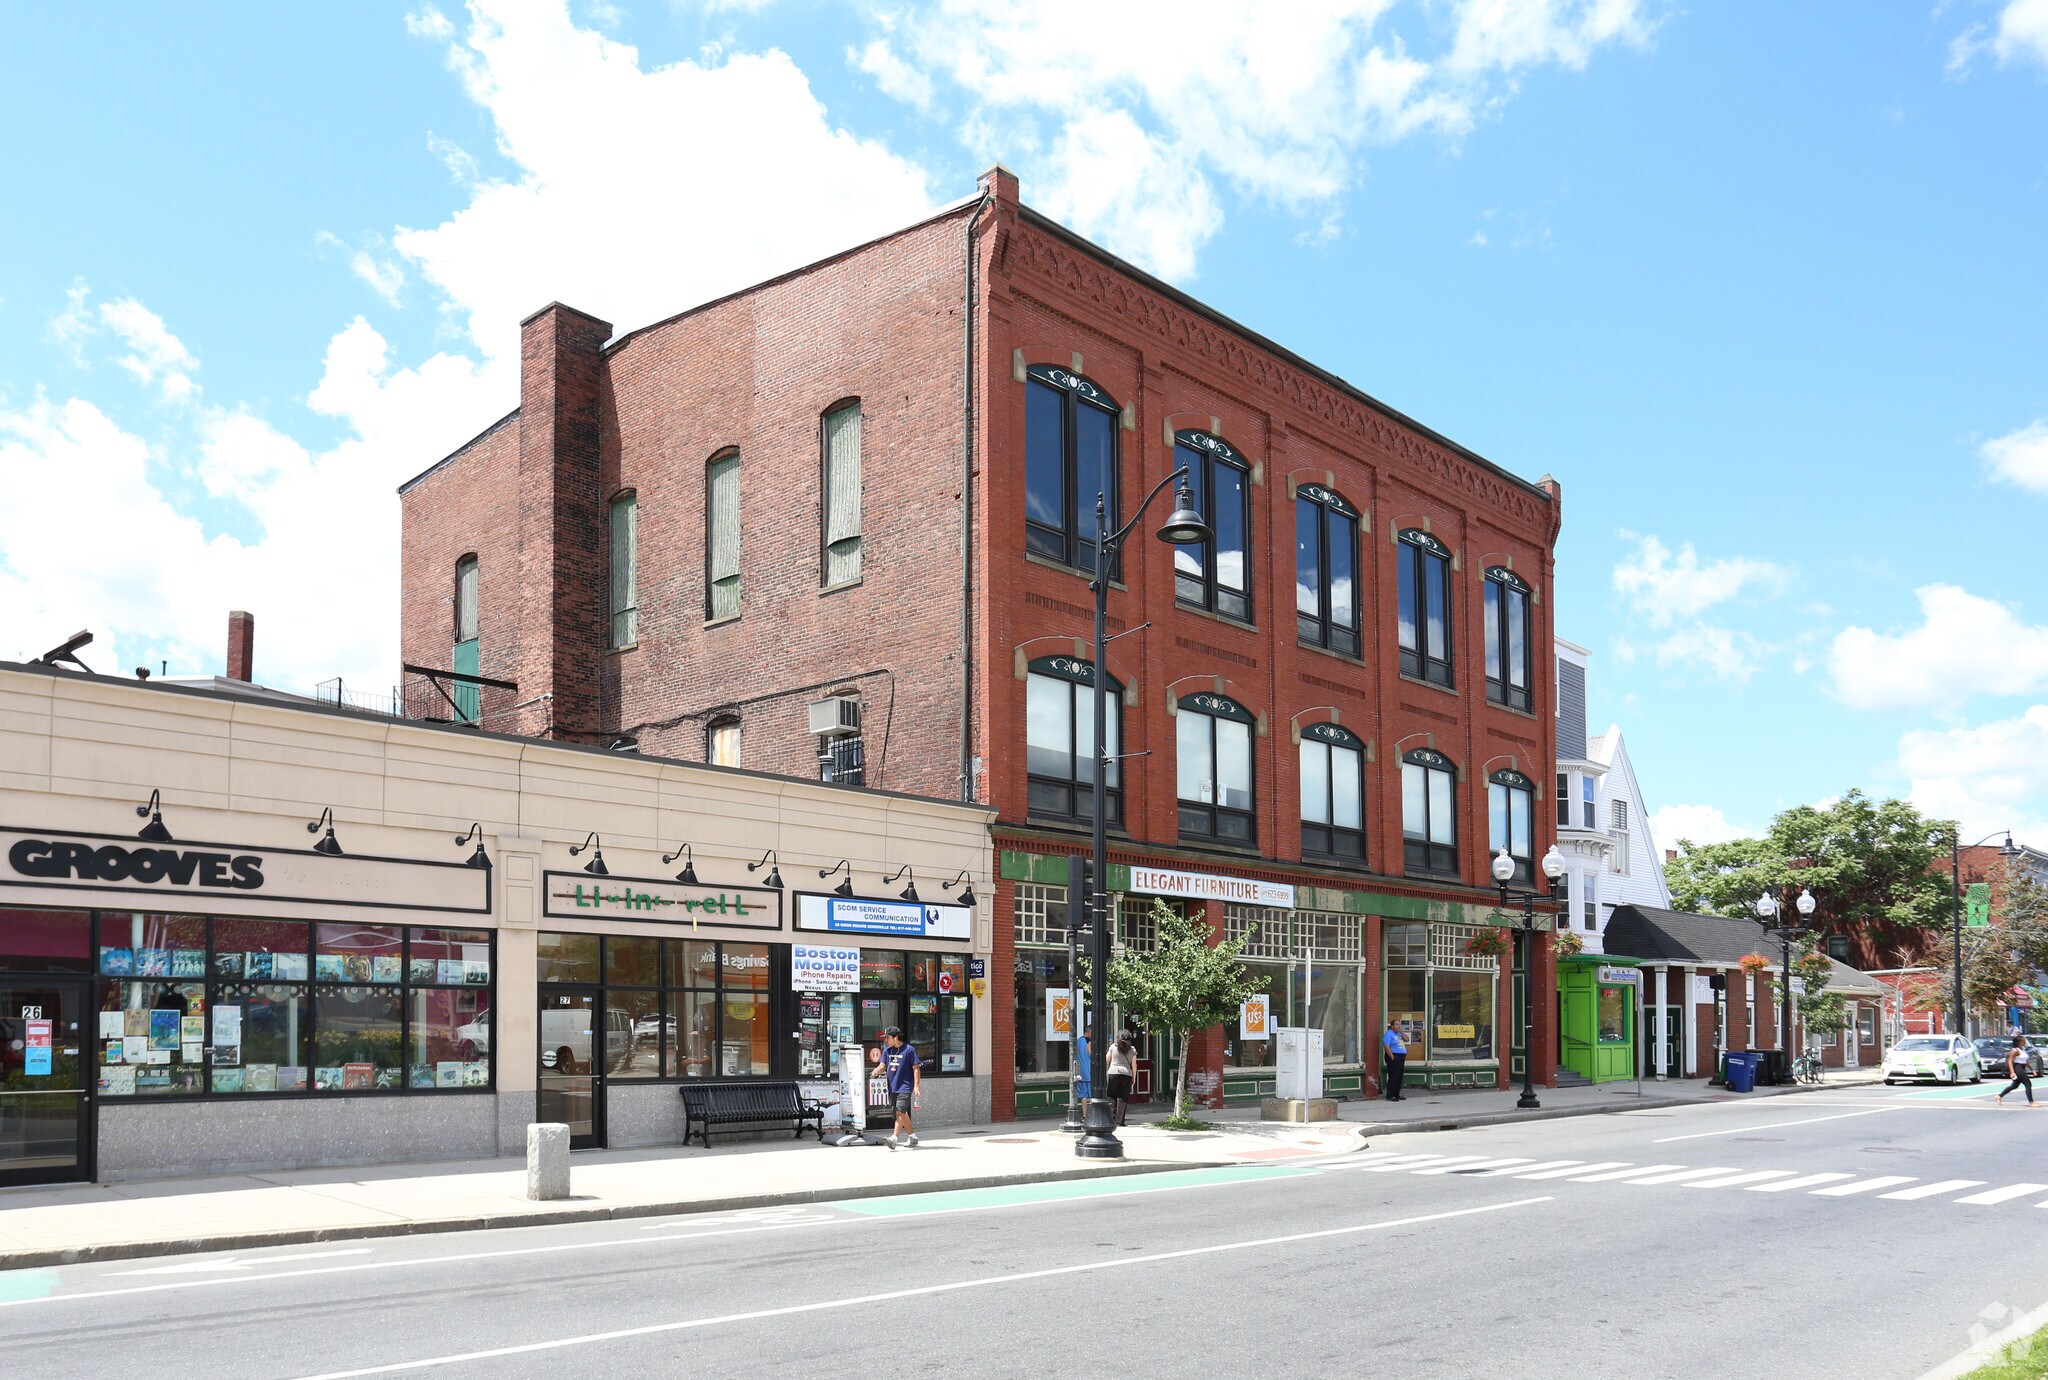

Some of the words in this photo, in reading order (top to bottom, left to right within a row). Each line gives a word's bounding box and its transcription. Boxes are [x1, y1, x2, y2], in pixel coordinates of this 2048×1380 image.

[8, 839, 265, 890] GROOVES
[1136, 871, 1191, 893] ELEGANT
[1194, 878, 1259, 900] FURNITURE
[837, 904, 857, 912] SCOM
[859, 906, 886, 914] SERVICE
[864, 913, 919, 923] COMMUNICATION
[794, 946, 858, 960] Boston
[794, 959, 858, 972] Mobile
[800, 971, 825, 979] iPhone
[826, 972, 852, 980] Repairs
[23, 1006, 40, 1019] 26
[1056, 1008, 1069, 1022] US
